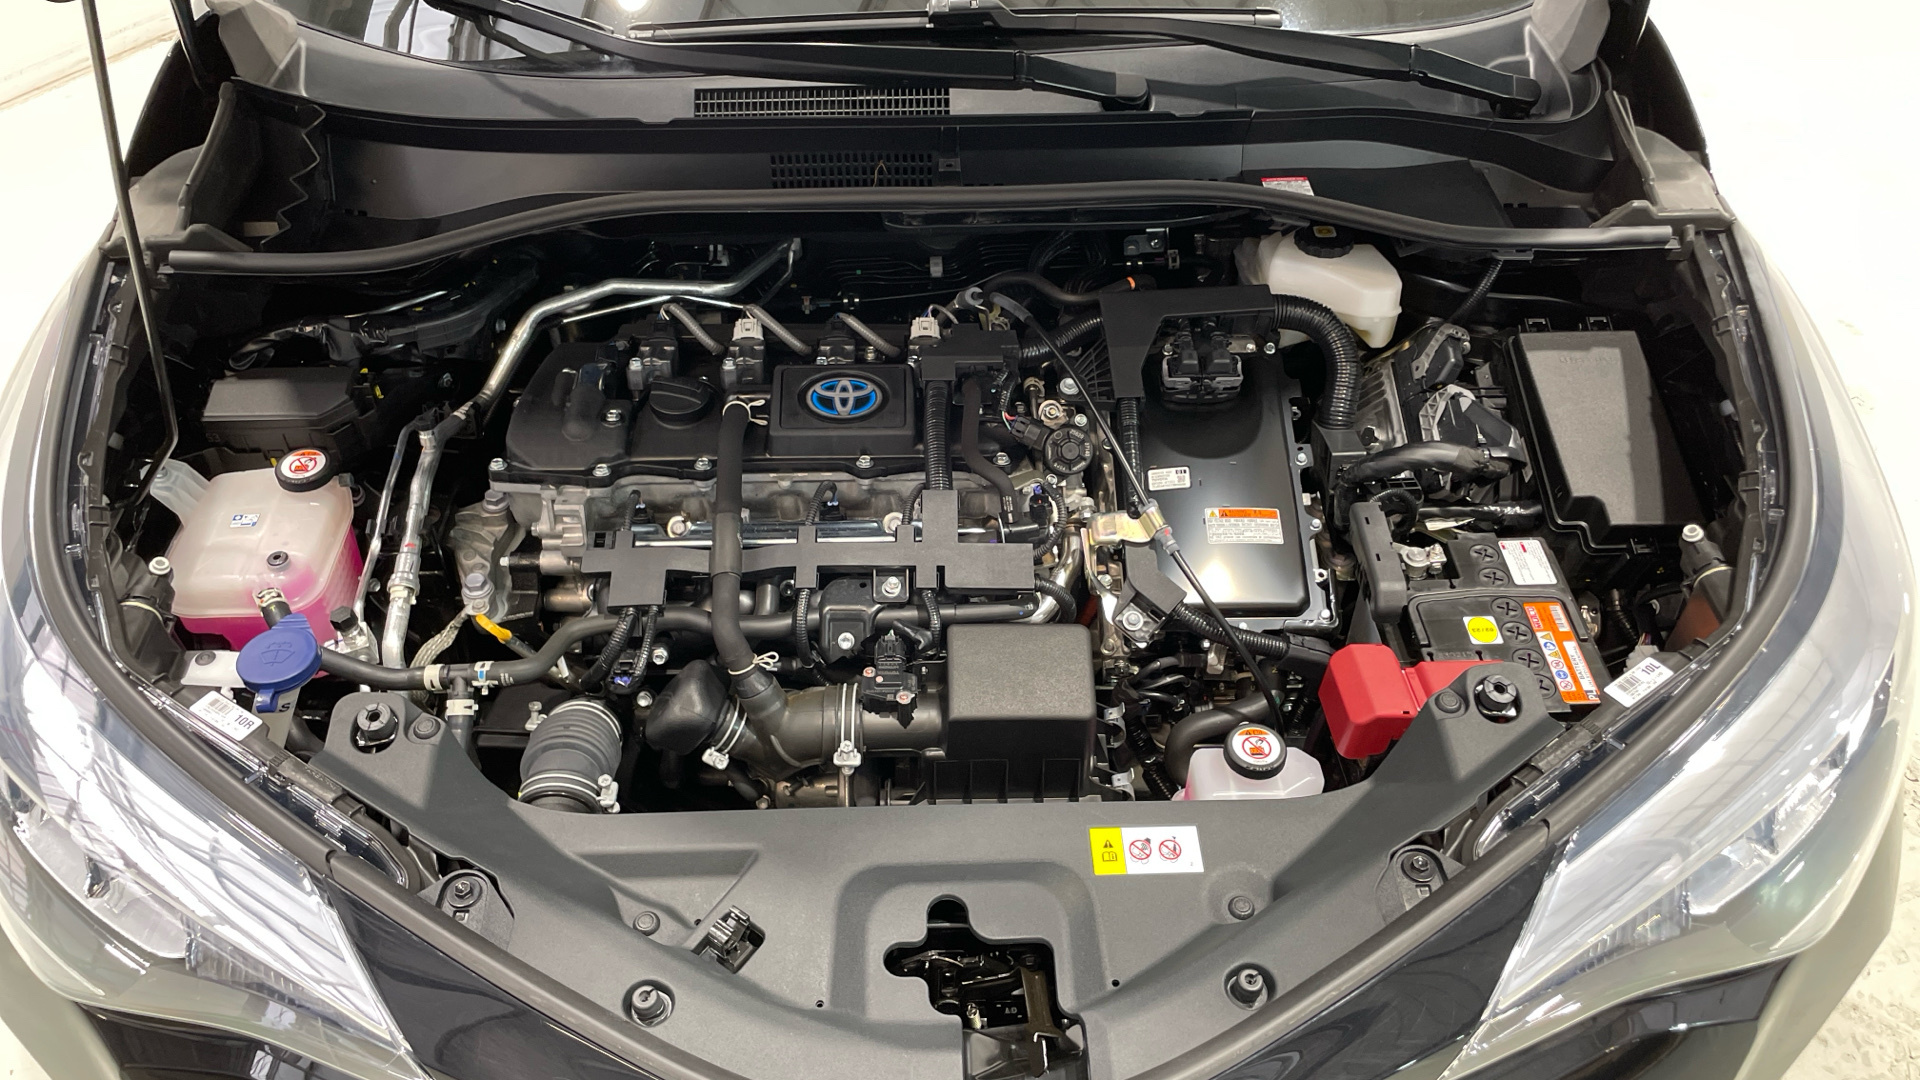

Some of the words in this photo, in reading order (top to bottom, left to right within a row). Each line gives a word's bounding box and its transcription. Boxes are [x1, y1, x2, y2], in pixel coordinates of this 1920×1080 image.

[1641, 662, 1661, 676] 10L
[279, 702, 291, 712] S
[235, 714, 255, 730] 10R
